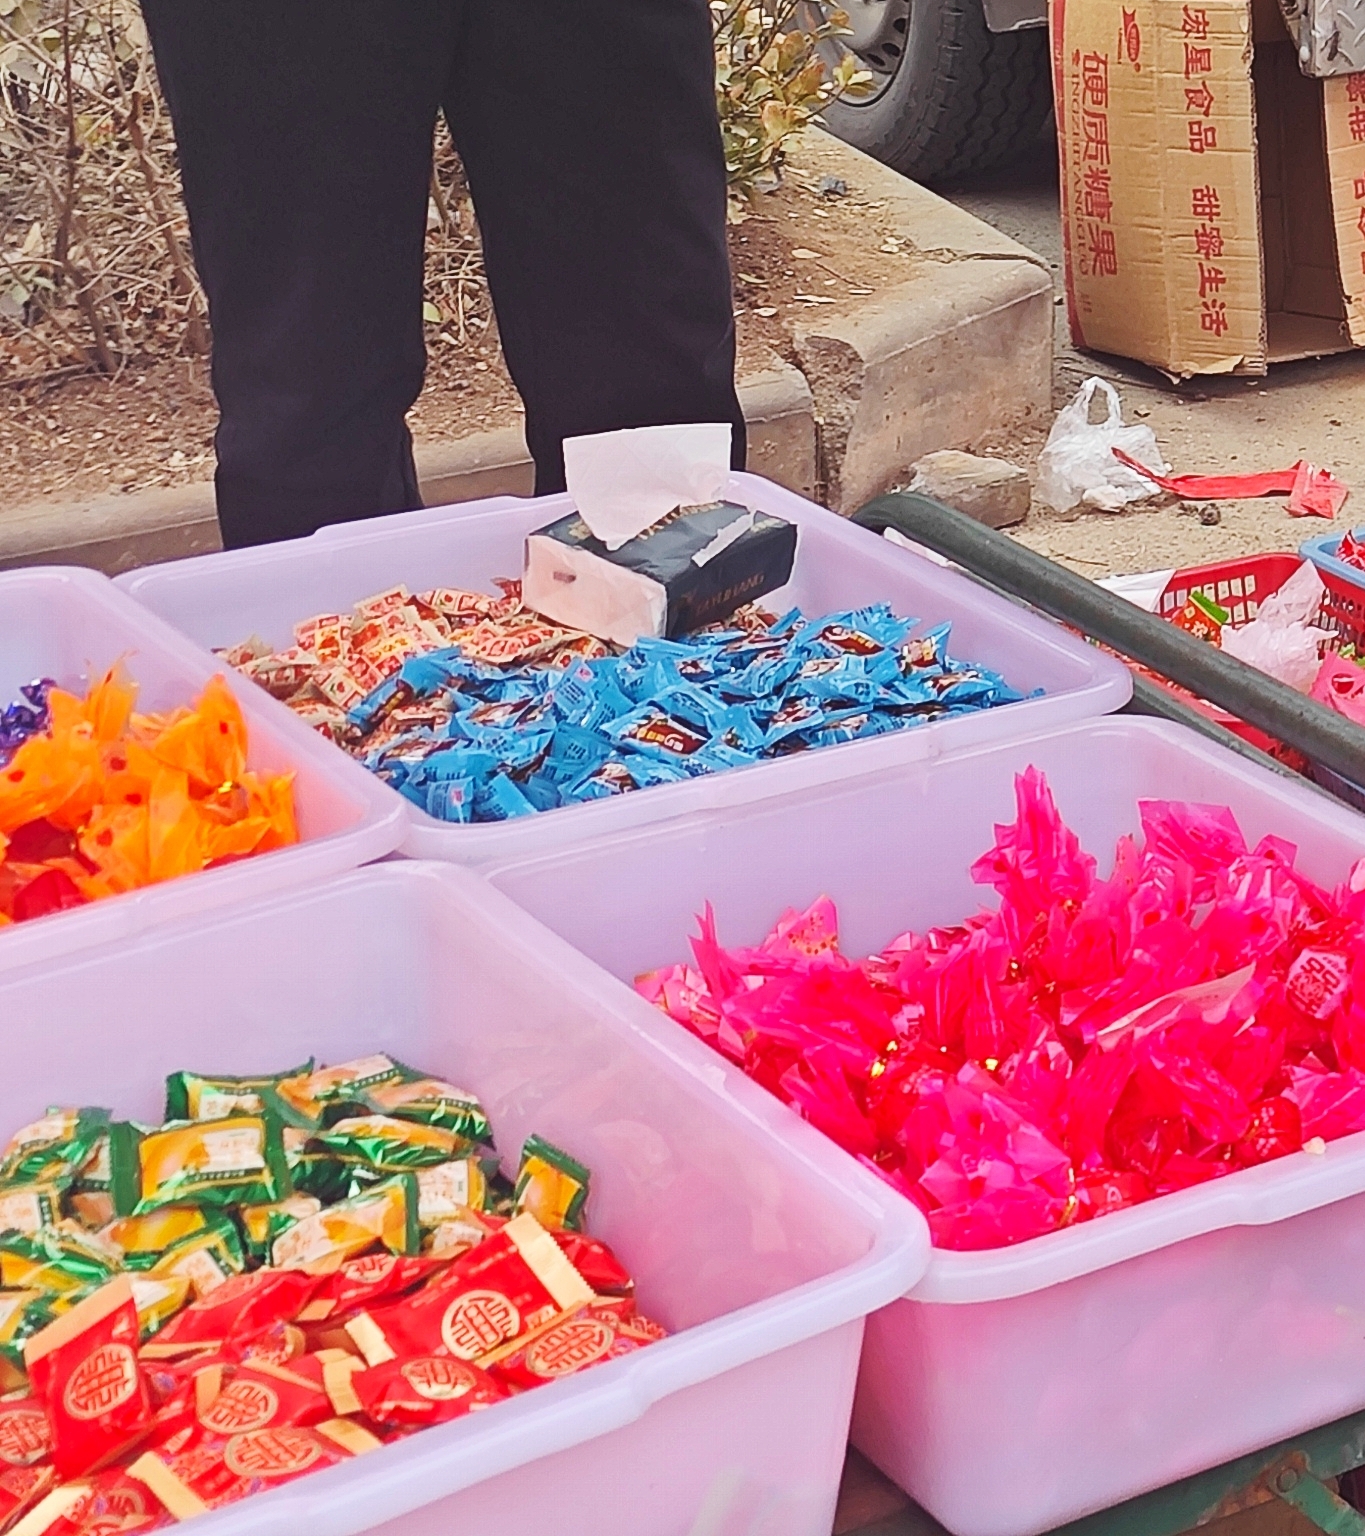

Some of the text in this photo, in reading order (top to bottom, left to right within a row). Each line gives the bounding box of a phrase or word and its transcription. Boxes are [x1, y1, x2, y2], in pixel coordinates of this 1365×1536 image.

[1081, 49, 1118, 279] 硬质糖果
[1180, 5, 1229, 338] 宏星食品 甜蜜生活
